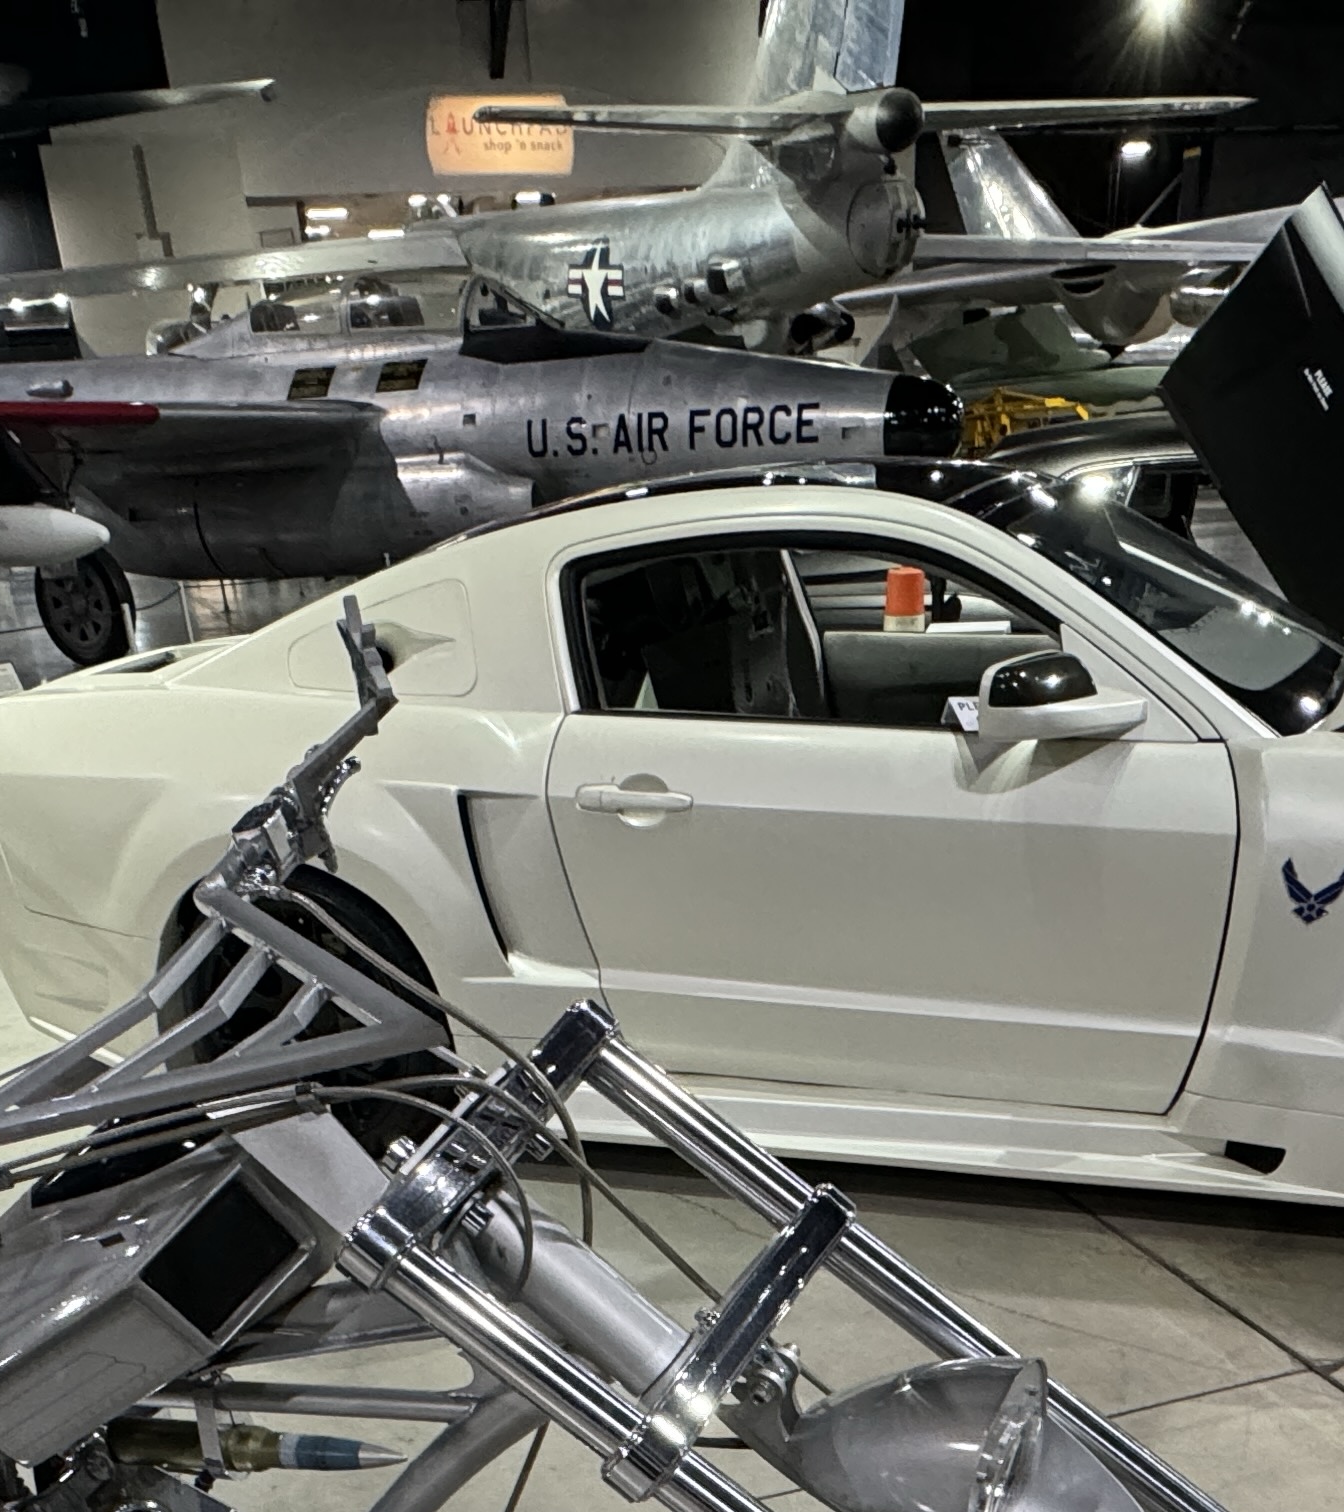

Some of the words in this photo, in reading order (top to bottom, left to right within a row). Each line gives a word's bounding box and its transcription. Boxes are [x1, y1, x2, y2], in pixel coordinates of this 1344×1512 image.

[483, 138, 512, 154] shop
[530, 139, 564, 151] snack
[526, 416, 599, 458] U.S.
[612, 411, 670, 454] AIR
[688, 402, 821, 450] FORCE
